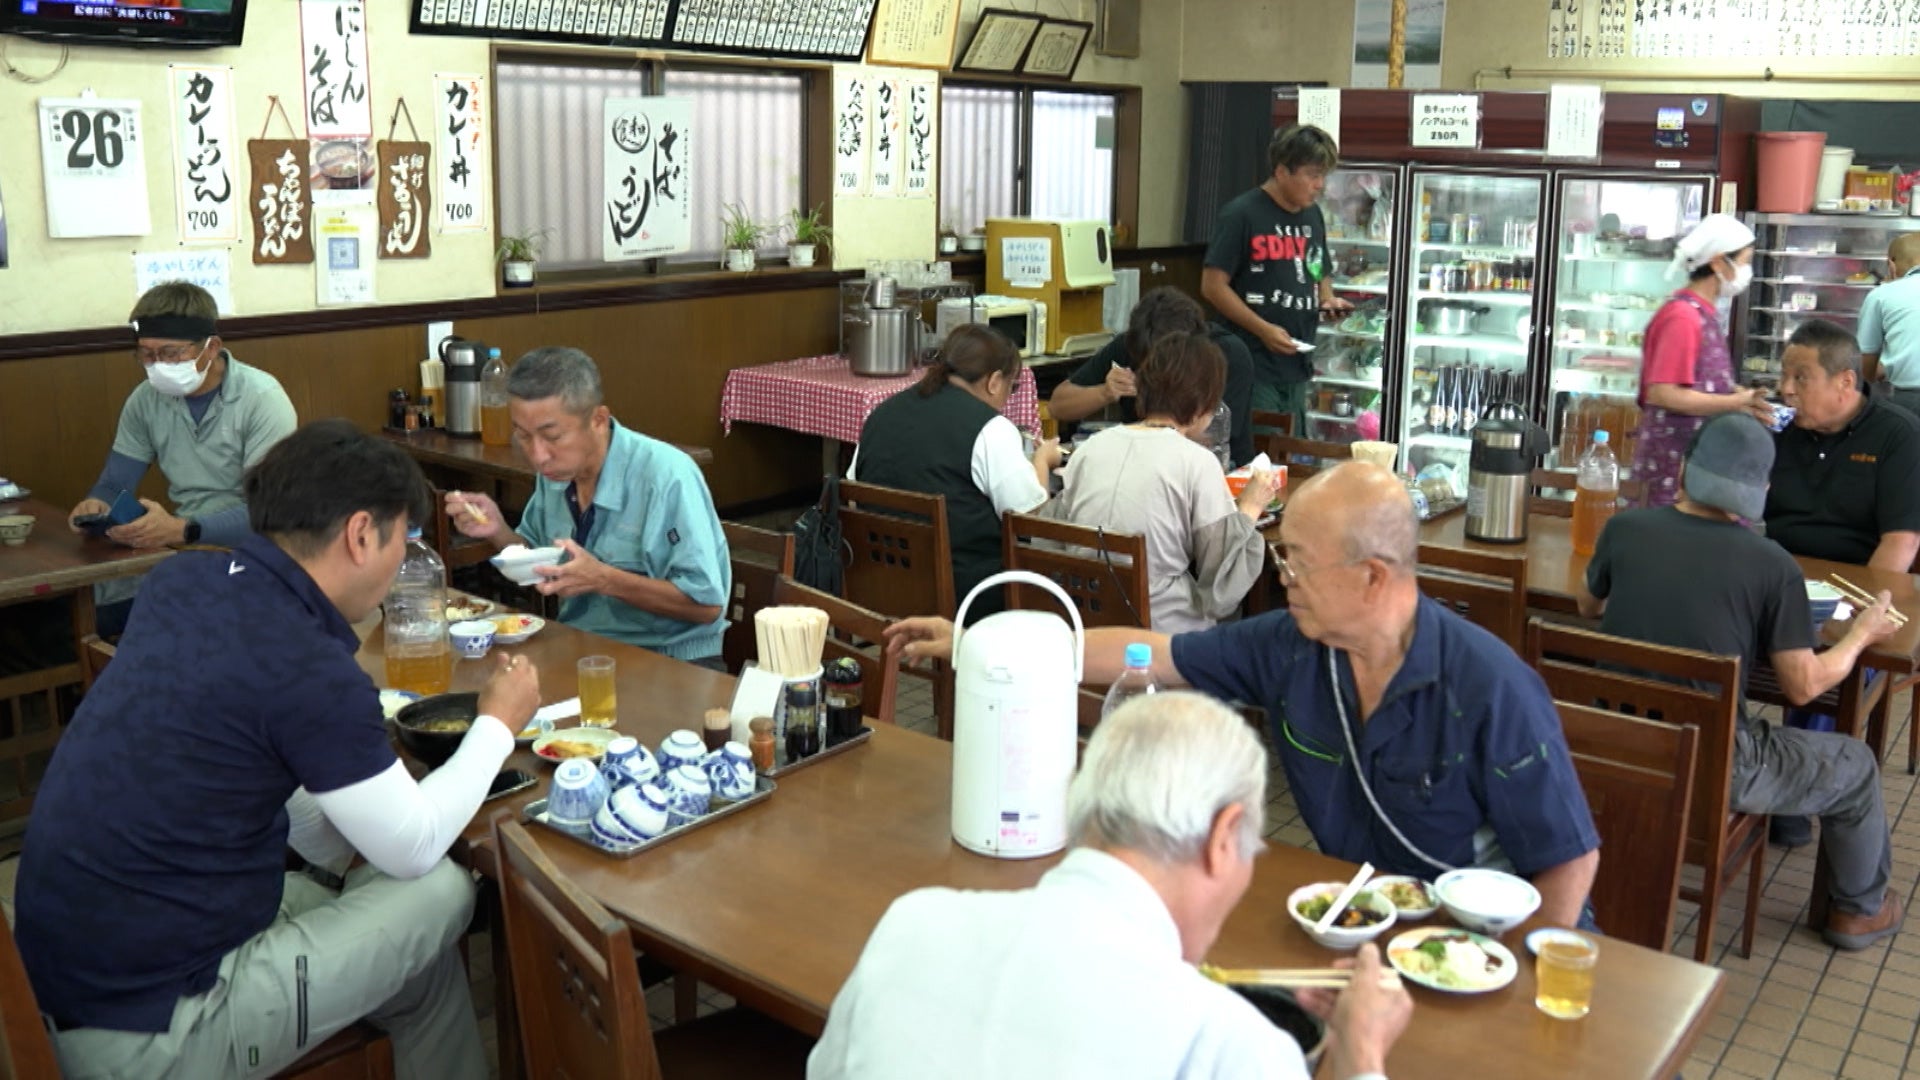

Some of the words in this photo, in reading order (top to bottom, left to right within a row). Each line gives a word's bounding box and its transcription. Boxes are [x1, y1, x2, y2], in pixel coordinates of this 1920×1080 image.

[310, 44, 339, 127] そば
[62, 109, 124, 168] 26
[184, 72, 231, 204] カレーうどん
[446, 81, 471, 189] カレー丼
[653, 122, 681, 208] そば
[188, 210, 218, 231] 700
[446, 203, 473, 221] 700
[608, 165, 651, 246] うどん
